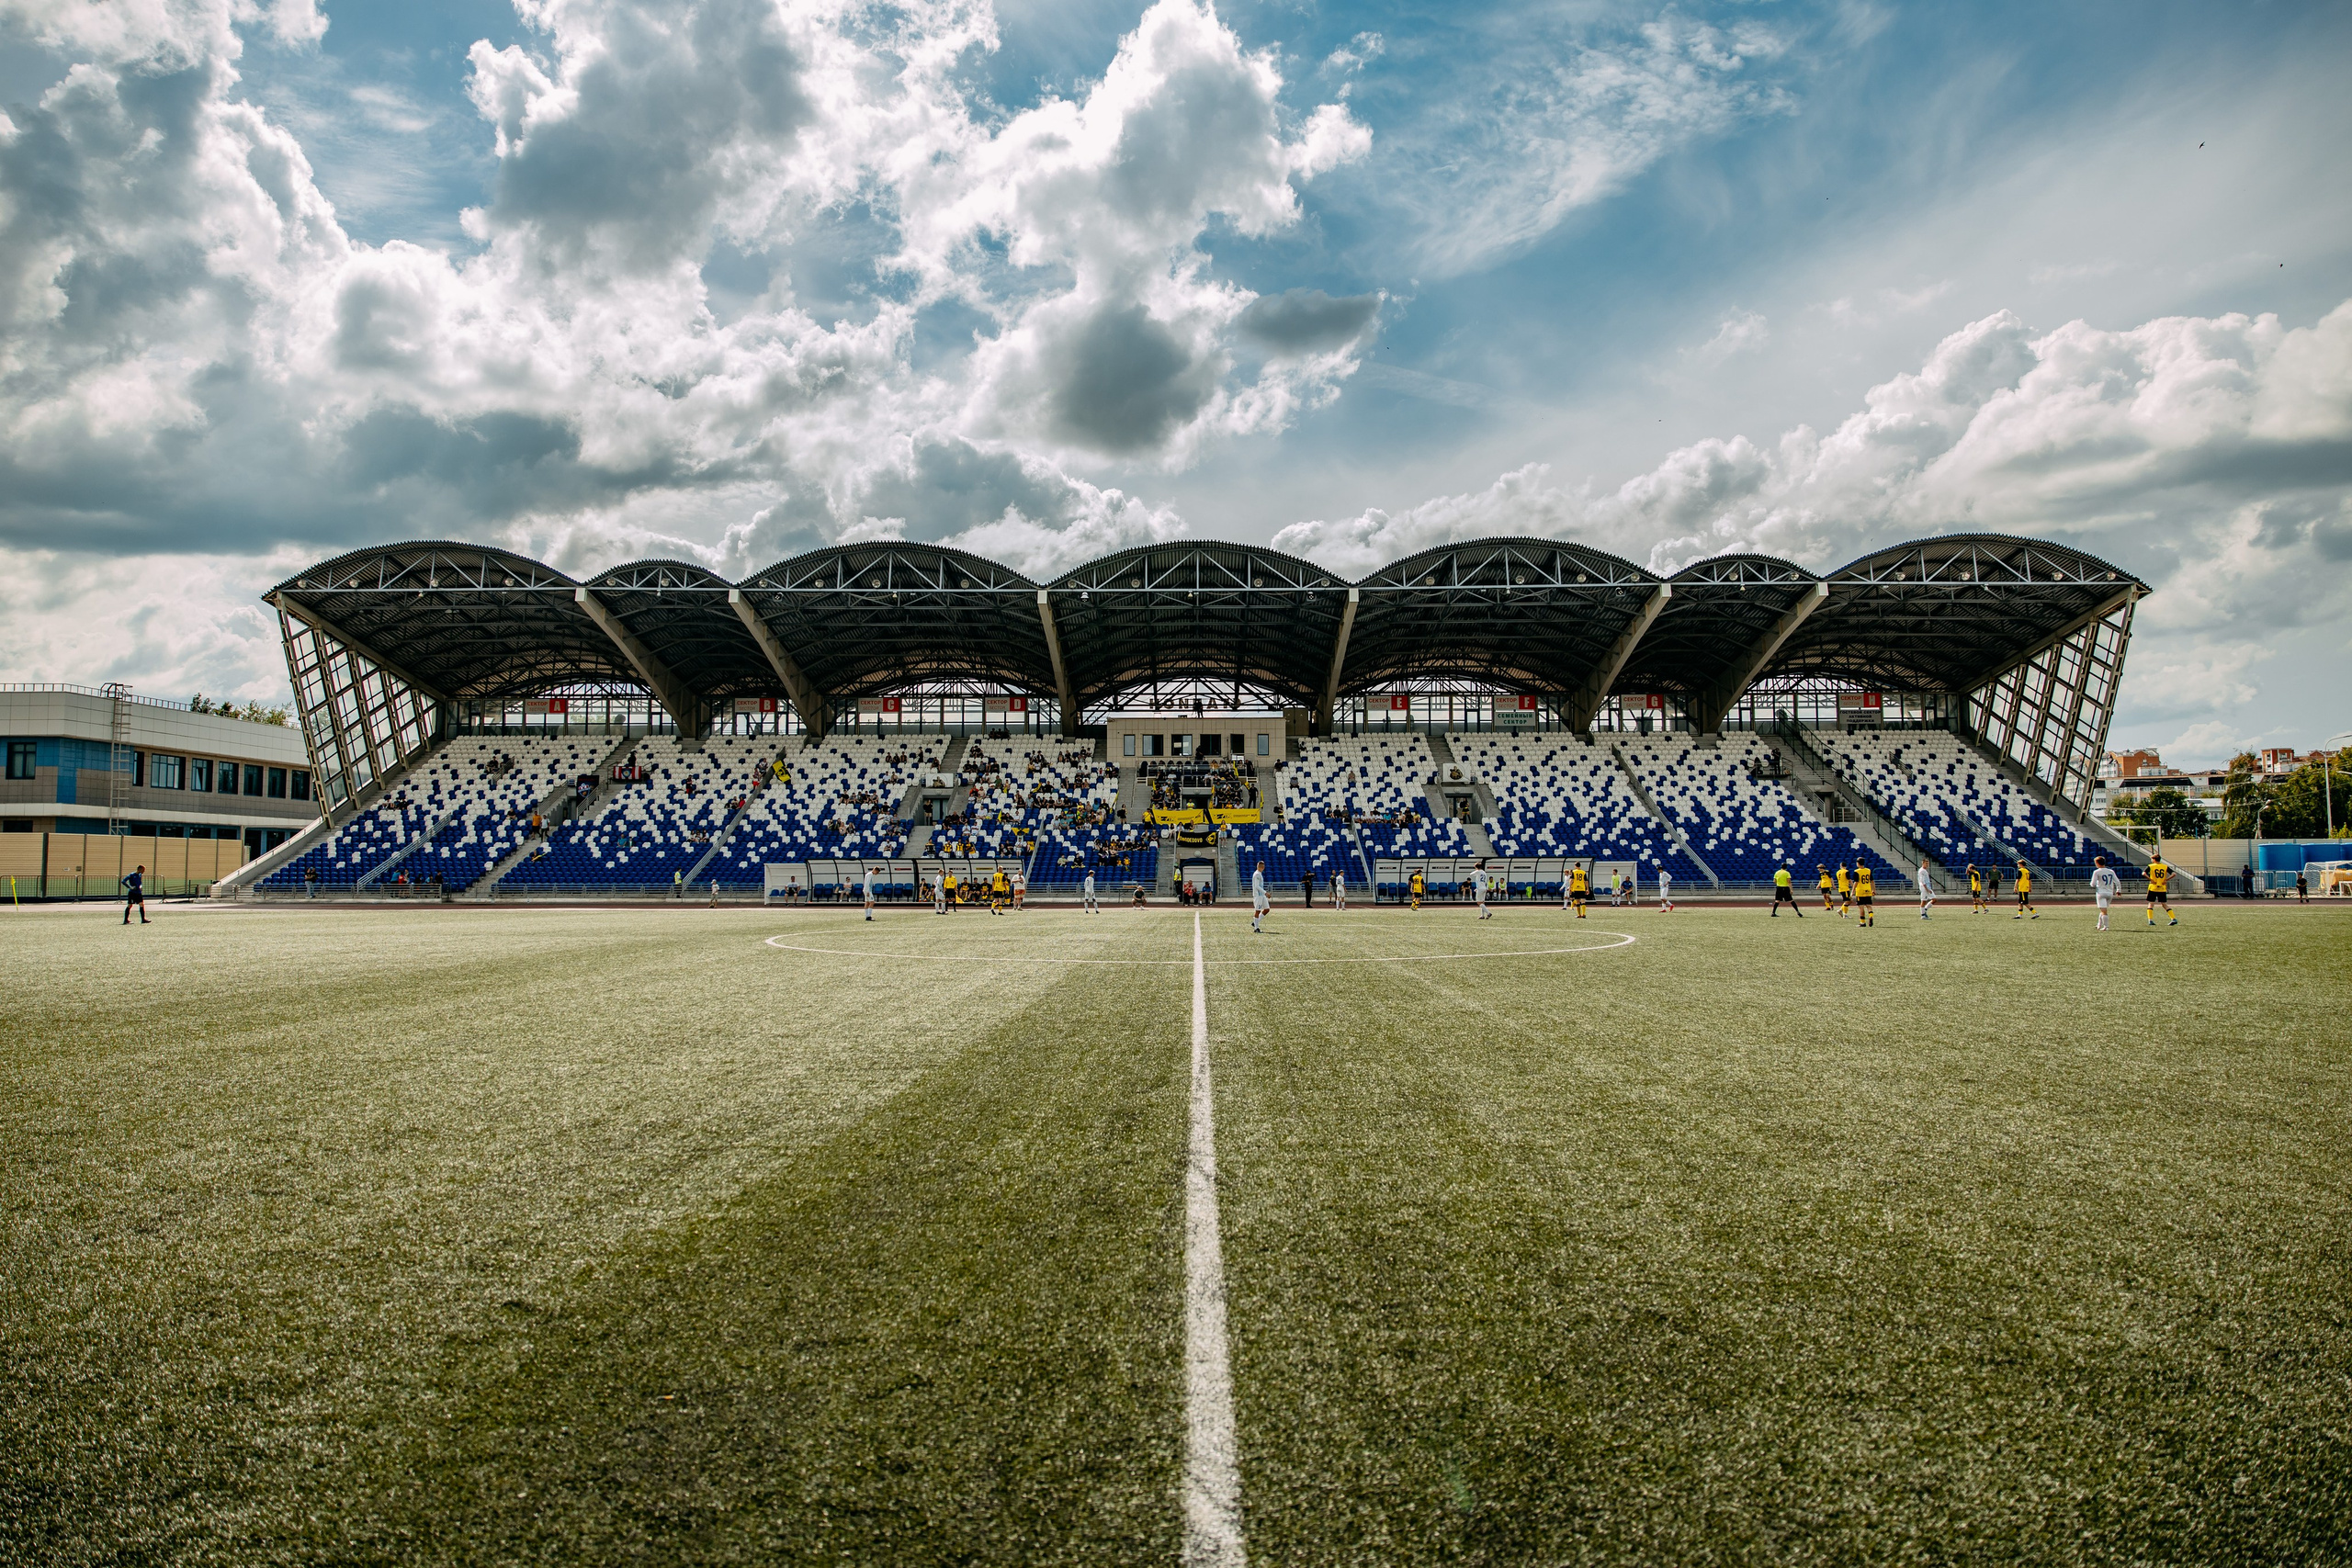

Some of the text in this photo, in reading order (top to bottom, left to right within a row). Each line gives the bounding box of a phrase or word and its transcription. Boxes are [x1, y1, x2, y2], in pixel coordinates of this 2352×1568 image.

[764, 699, 771, 710] B
[888, 699, 894, 710] C
[1014, 698, 1021, 709] D
[1397, 697, 1402, 708] E
[1525, 696, 1530, 708] F
[1652, 695, 1658, 706] G
[1869, 694, 1875, 705] H
[554, 700, 560, 711] A
[1576, 873, 1583, 881] 18
[1860, 874, 1870, 885] 69
[2154, 869, 2165, 879] 66
[2101, 874, 2113, 886] 97
